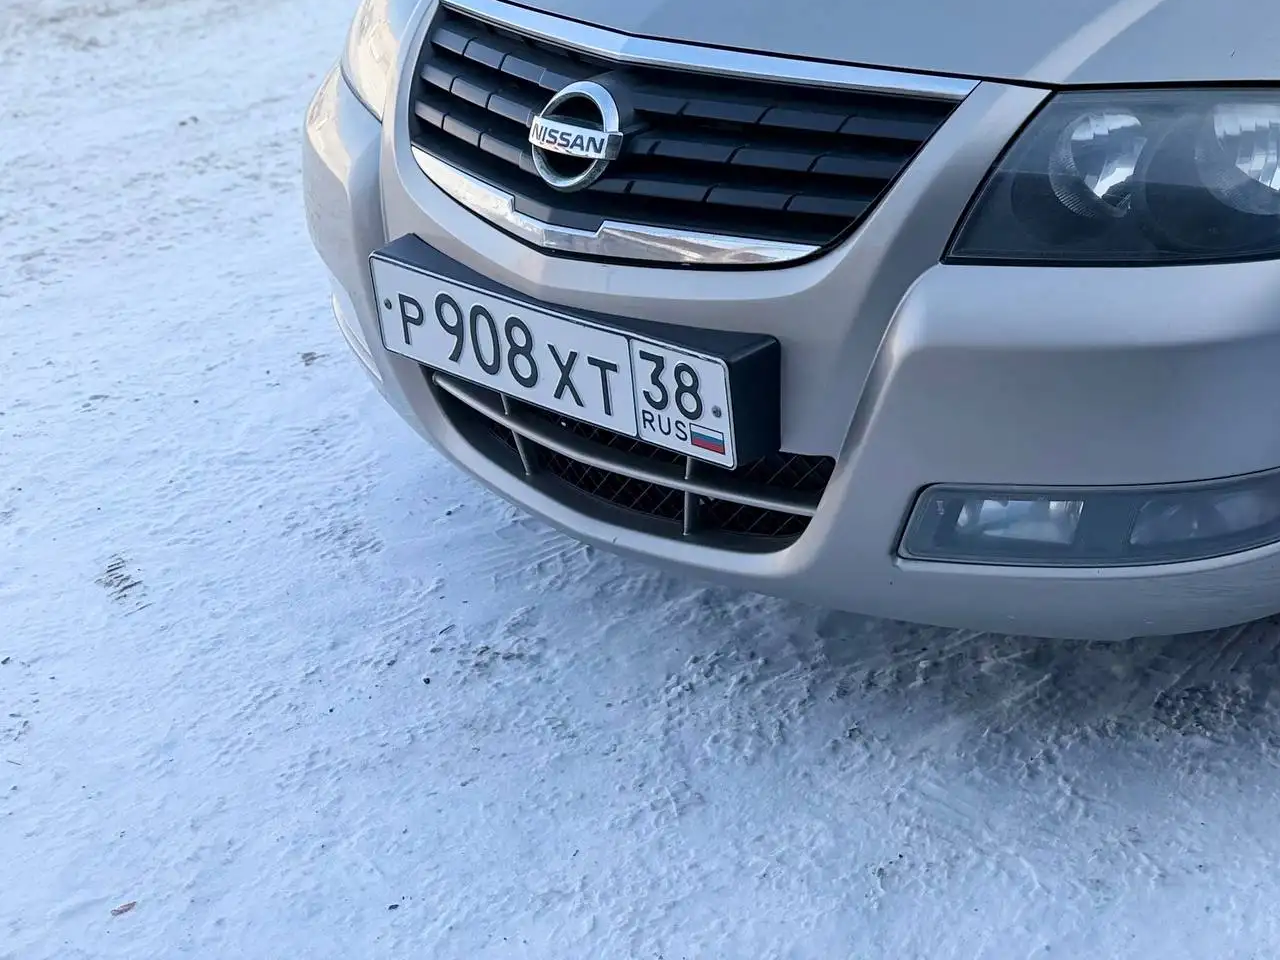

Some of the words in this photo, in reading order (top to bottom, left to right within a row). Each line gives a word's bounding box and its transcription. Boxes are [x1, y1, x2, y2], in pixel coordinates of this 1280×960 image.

[531, 122, 605, 154] NISSAN
[638, 349, 703, 421] 38
[641, 409, 688, 442] RUS
